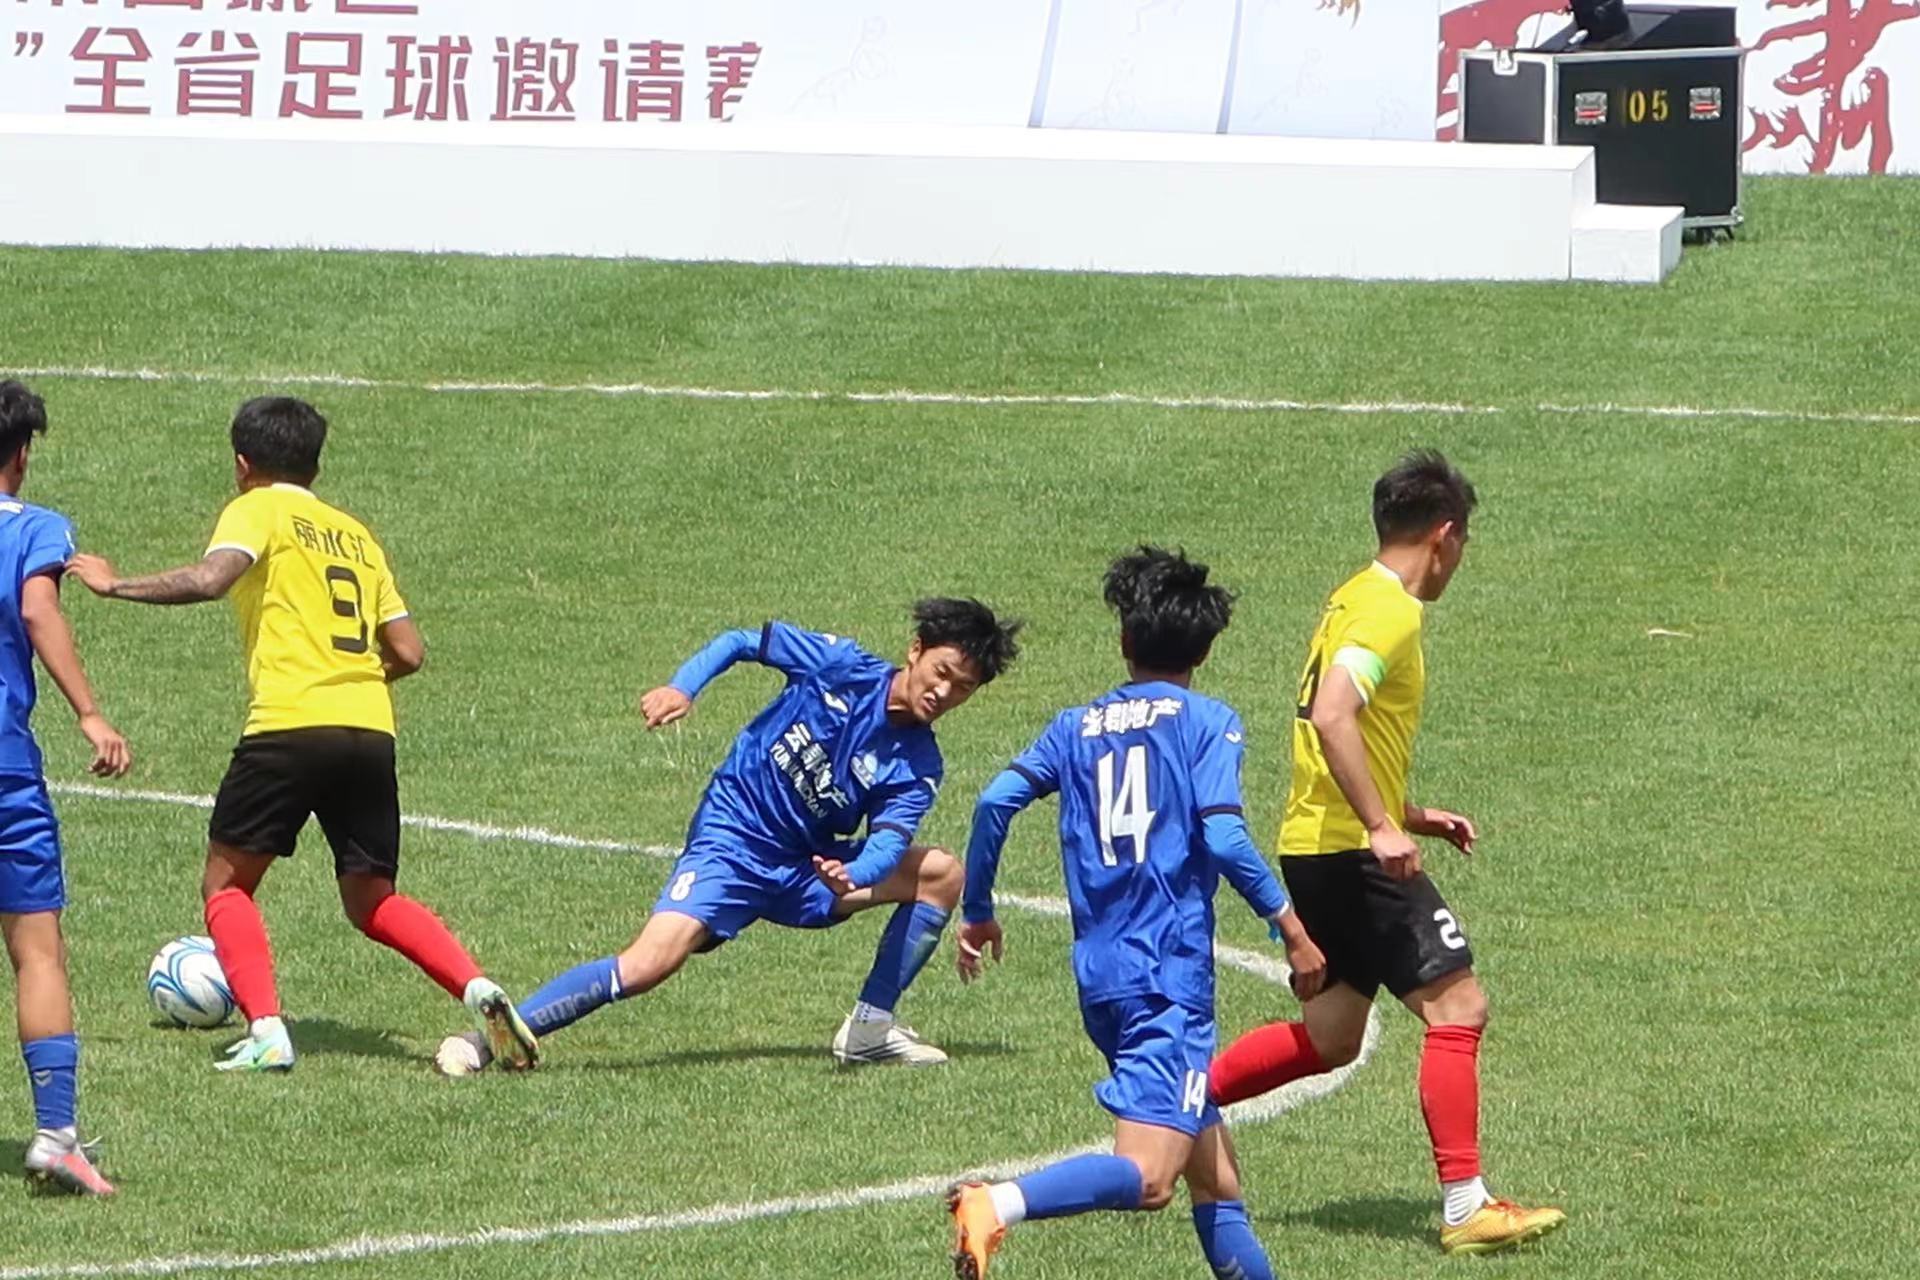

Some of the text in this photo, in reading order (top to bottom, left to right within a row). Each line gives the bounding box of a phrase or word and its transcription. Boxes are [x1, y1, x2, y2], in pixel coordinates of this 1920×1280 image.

[1629, 89, 1669, 123] 05
[325, 564, 369, 655] 9
[1098, 745, 1157, 867] 14
[1433, 908, 1466, 950] 2
[1182, 1068, 1207, 1119] 14
